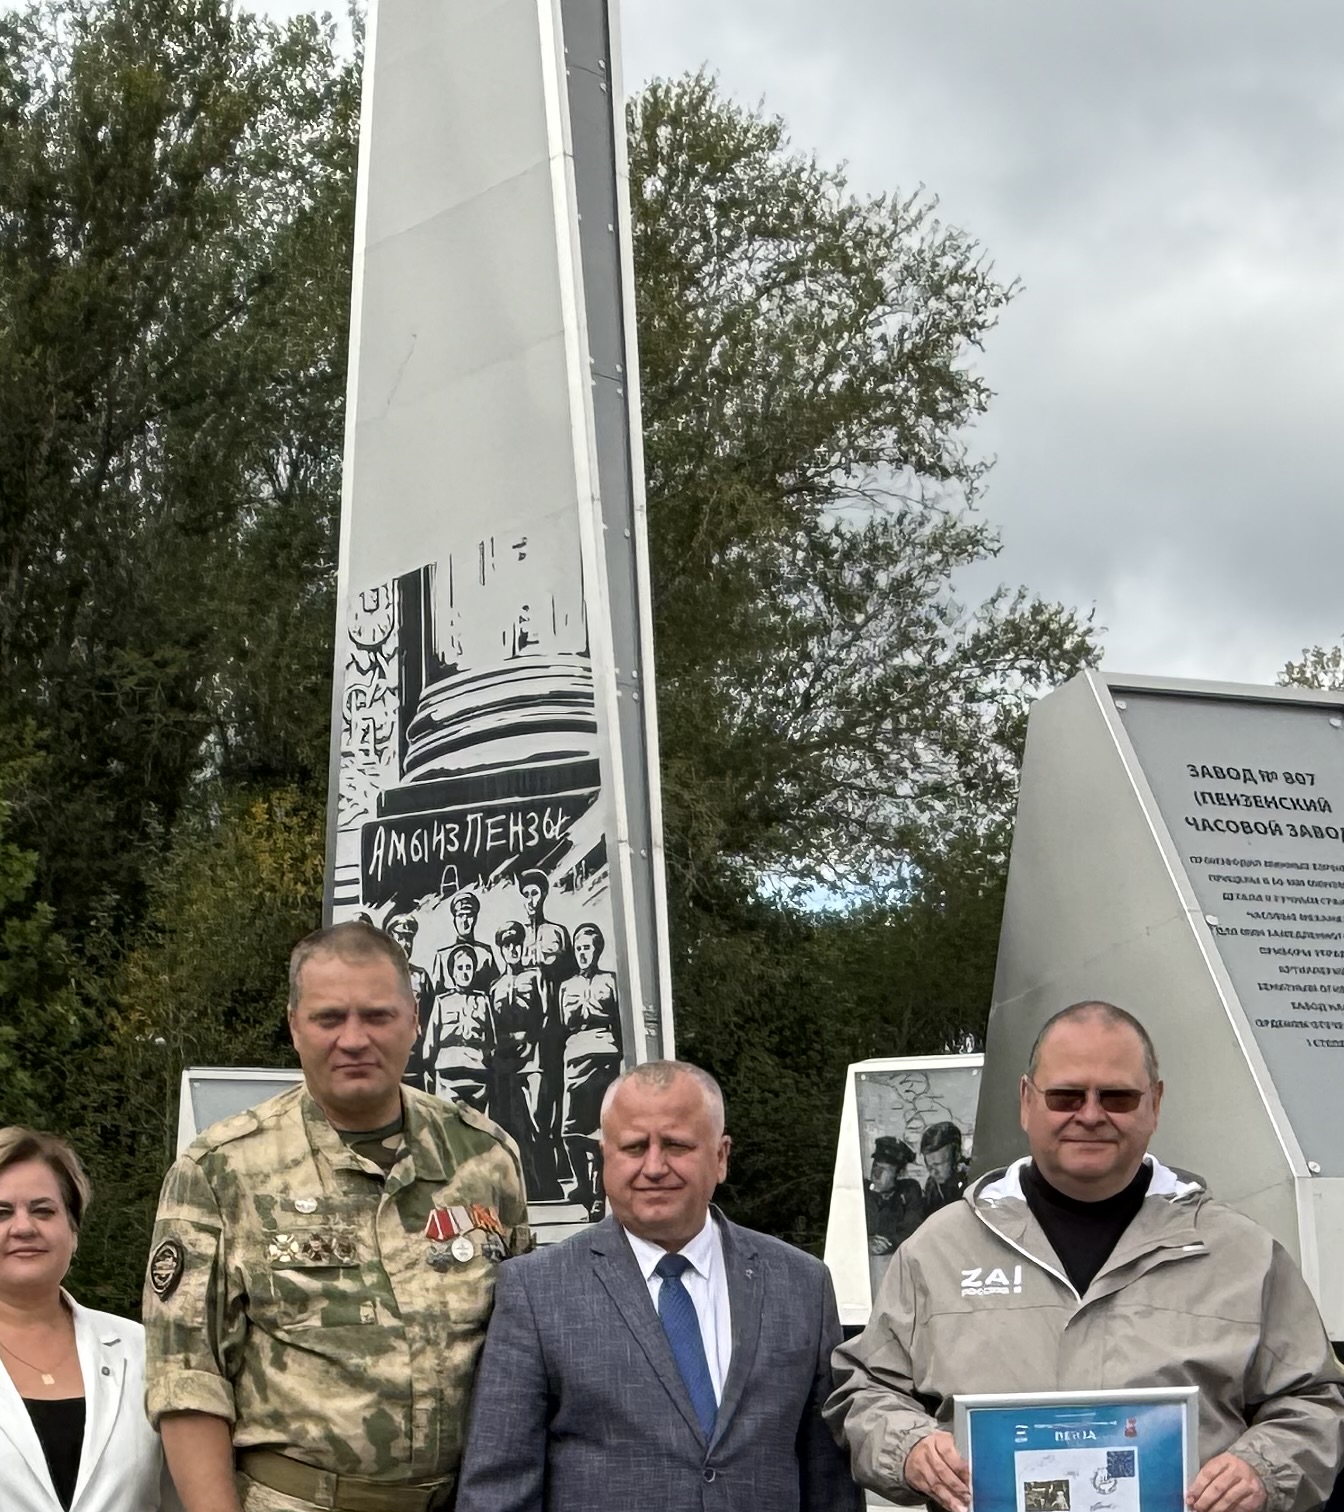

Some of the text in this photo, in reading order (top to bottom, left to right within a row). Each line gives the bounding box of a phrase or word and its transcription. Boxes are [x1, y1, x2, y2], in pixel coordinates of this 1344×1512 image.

[1186, 763, 1258, 785] ЗАВОД
[1283, 771, 1316, 787] 807
[1193, 790, 1333, 814] (ПЕНЗЕНСКИЙ
[463, 806, 571, 858] ПЕНЗЫ
[1184, 815, 1284, 837] ЧАСОВОЙ
